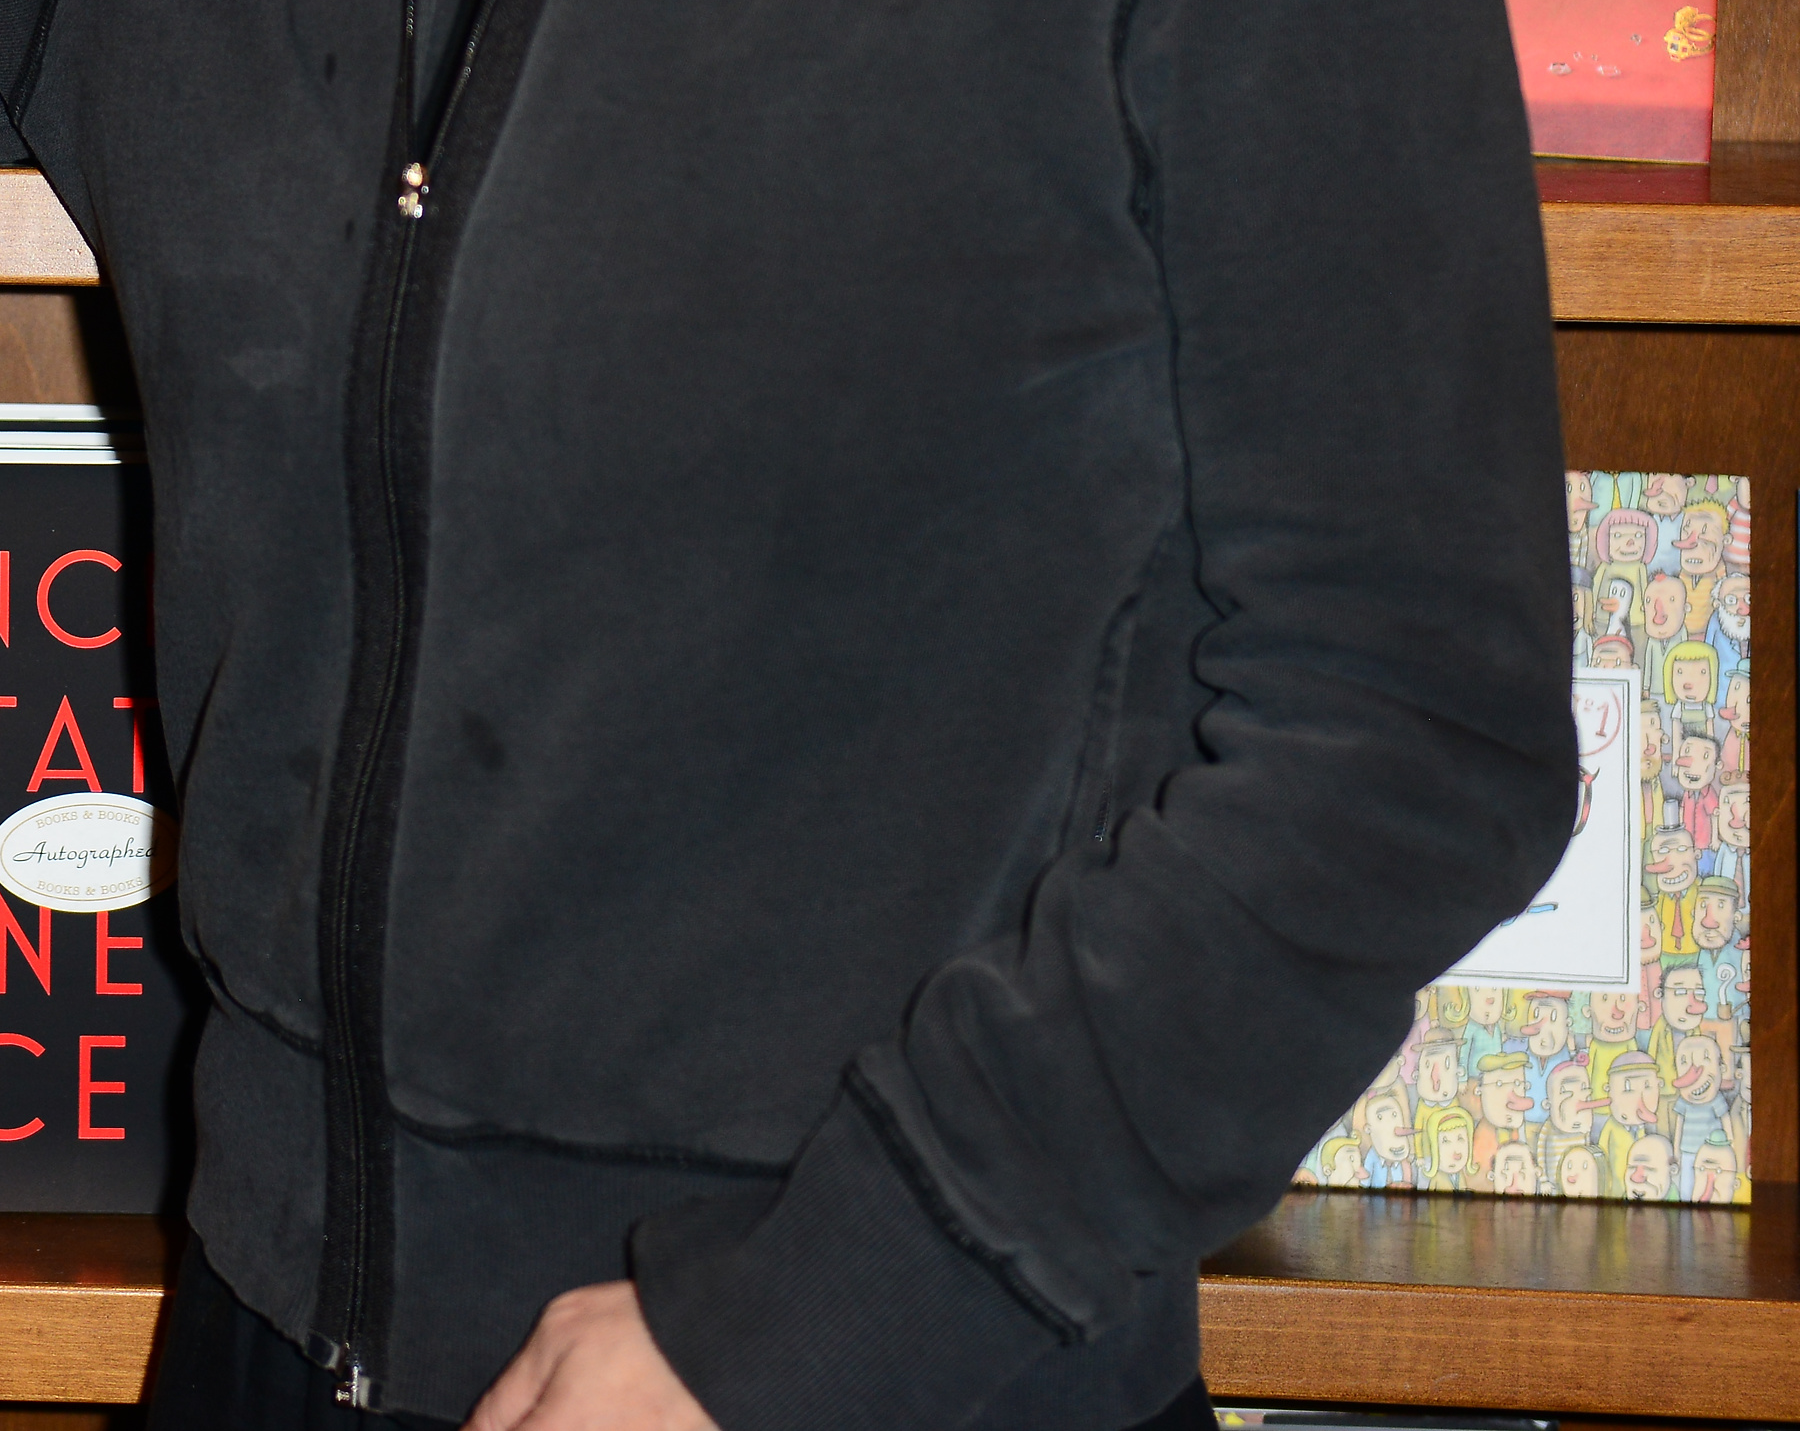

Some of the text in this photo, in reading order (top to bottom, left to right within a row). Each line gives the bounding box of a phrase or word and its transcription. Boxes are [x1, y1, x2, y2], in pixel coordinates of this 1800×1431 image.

[36, 811, 78, 829] BOOKS
[98, 810, 141, 826] BOOKS
[13, 837, 158, 869] Autographed
[37, 880, 80, 896] BOOKS
[101, 876, 143, 895] BOOKS
